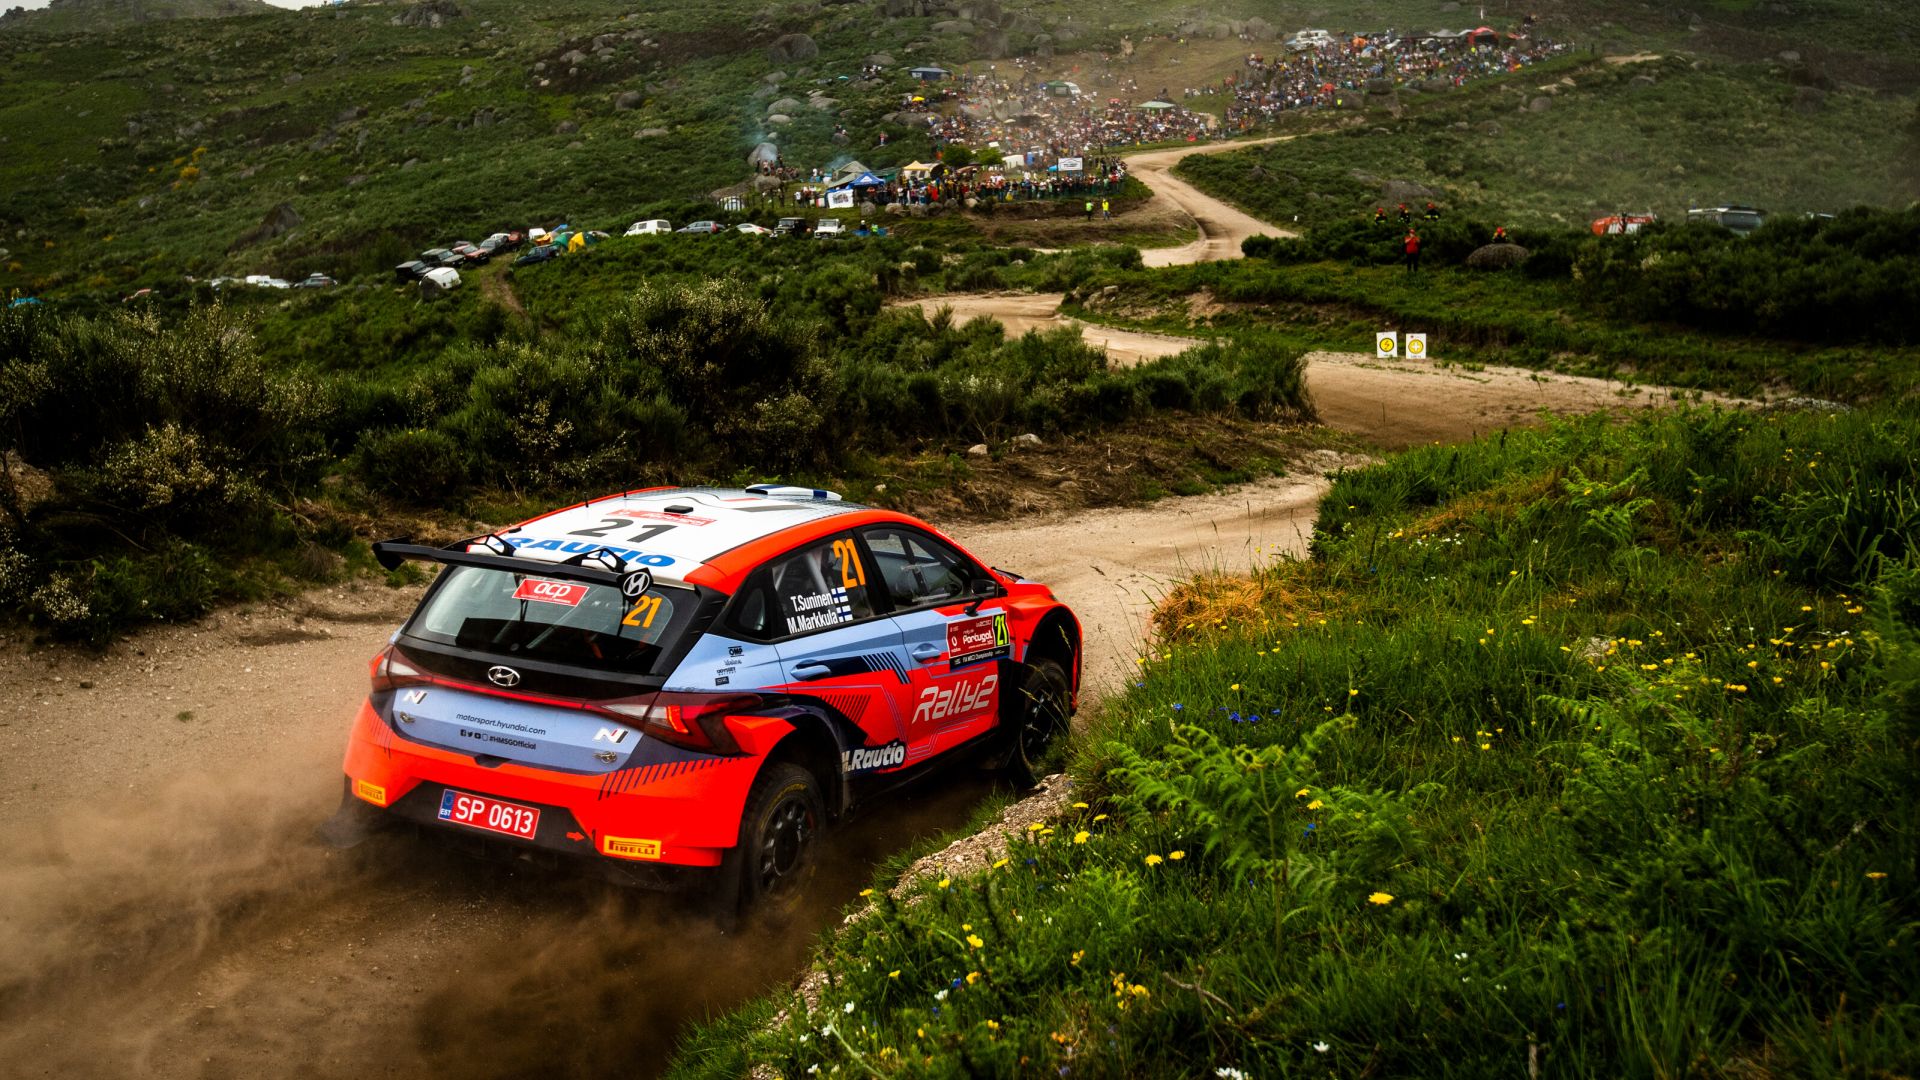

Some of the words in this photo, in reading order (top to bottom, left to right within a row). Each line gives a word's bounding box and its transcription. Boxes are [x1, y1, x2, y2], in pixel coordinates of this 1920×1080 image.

[567, 518, 679, 543] 21
[495, 537, 676, 567] RAUTIO
[833, 538, 866, 589] 21
[533, 582, 571, 598] acp
[790, 592, 834, 612] T.Suninen
[622, 595, 663, 629] 21
[786, 609, 839, 634] M.Markkula
[962, 630, 993, 645] Portugal
[994, 614, 1008, 646] 21
[728, 647, 743, 656] OMP
[911, 674, 998, 724] Rally2
[456, 713, 546, 735] motorsport.hyundai.com
[440, 808, 452, 816] EST
[455, 797, 485, 822] SP
[488, 804, 534, 833] 0613
[608, 840, 656, 855] PIRELLI
